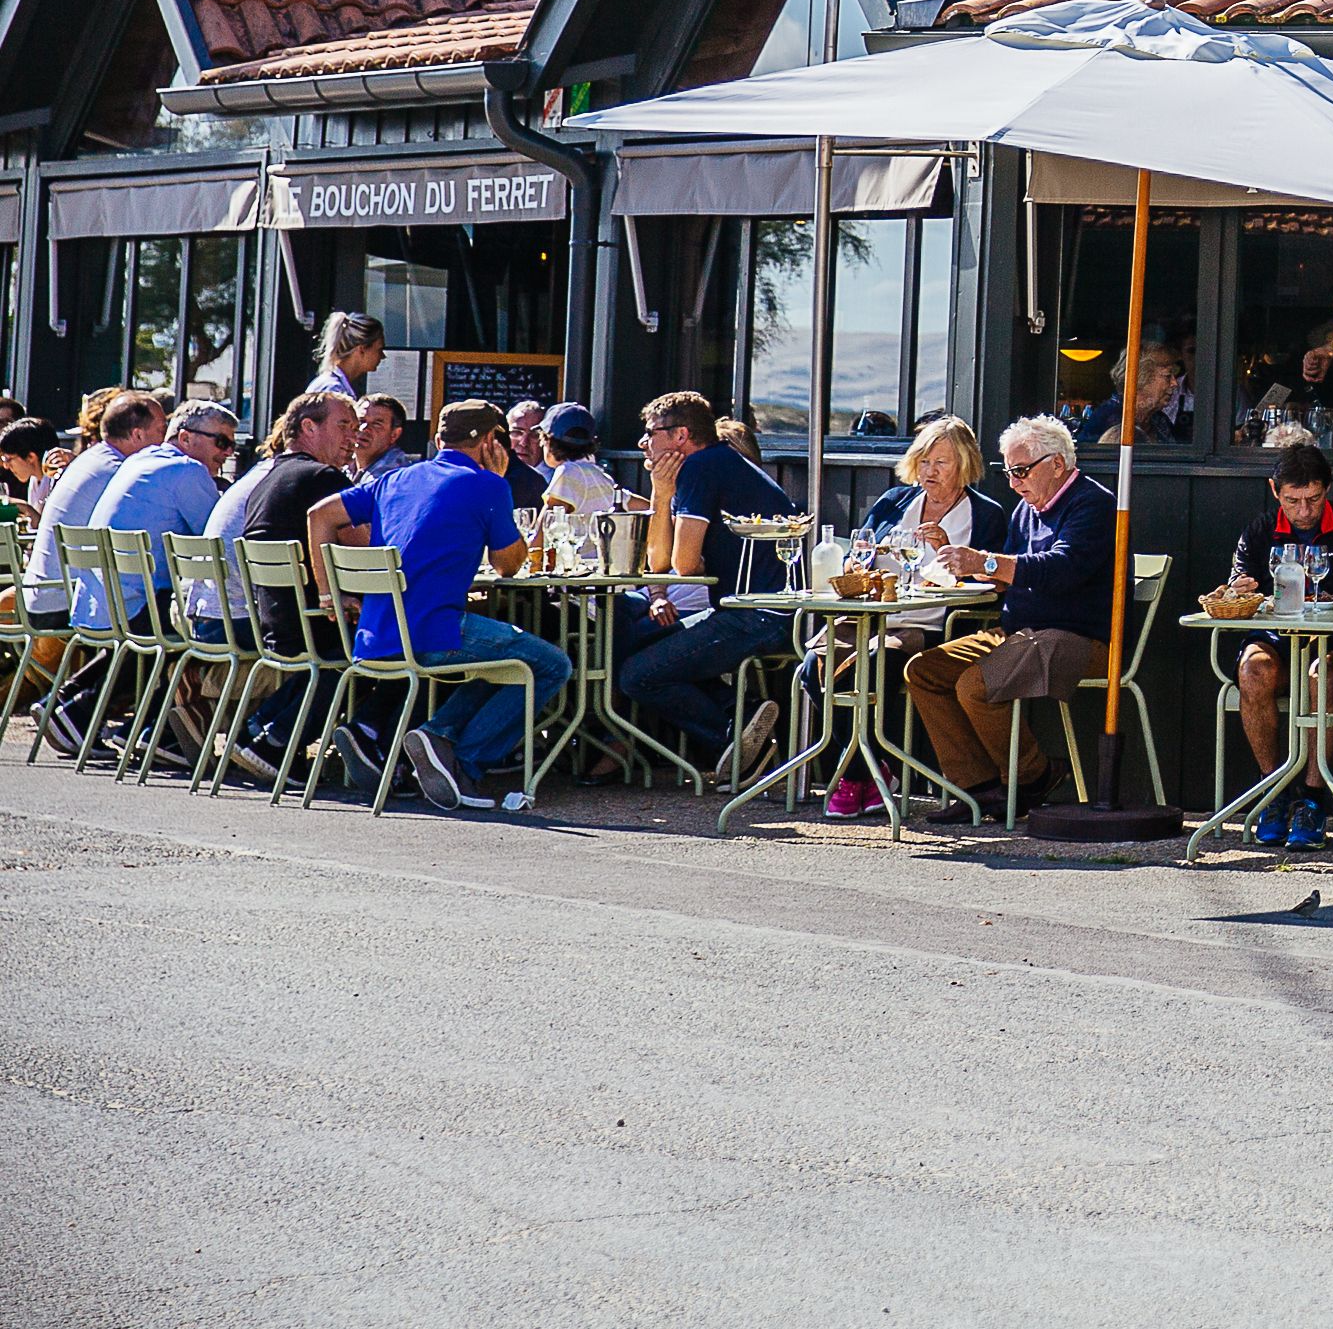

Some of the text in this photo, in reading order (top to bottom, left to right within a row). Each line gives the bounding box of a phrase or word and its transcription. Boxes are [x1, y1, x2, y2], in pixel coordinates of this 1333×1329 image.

[309, 182, 417, 218] BOUCHON
[424, 180, 456, 214] DU
[467, 174, 554, 212] FERRET
